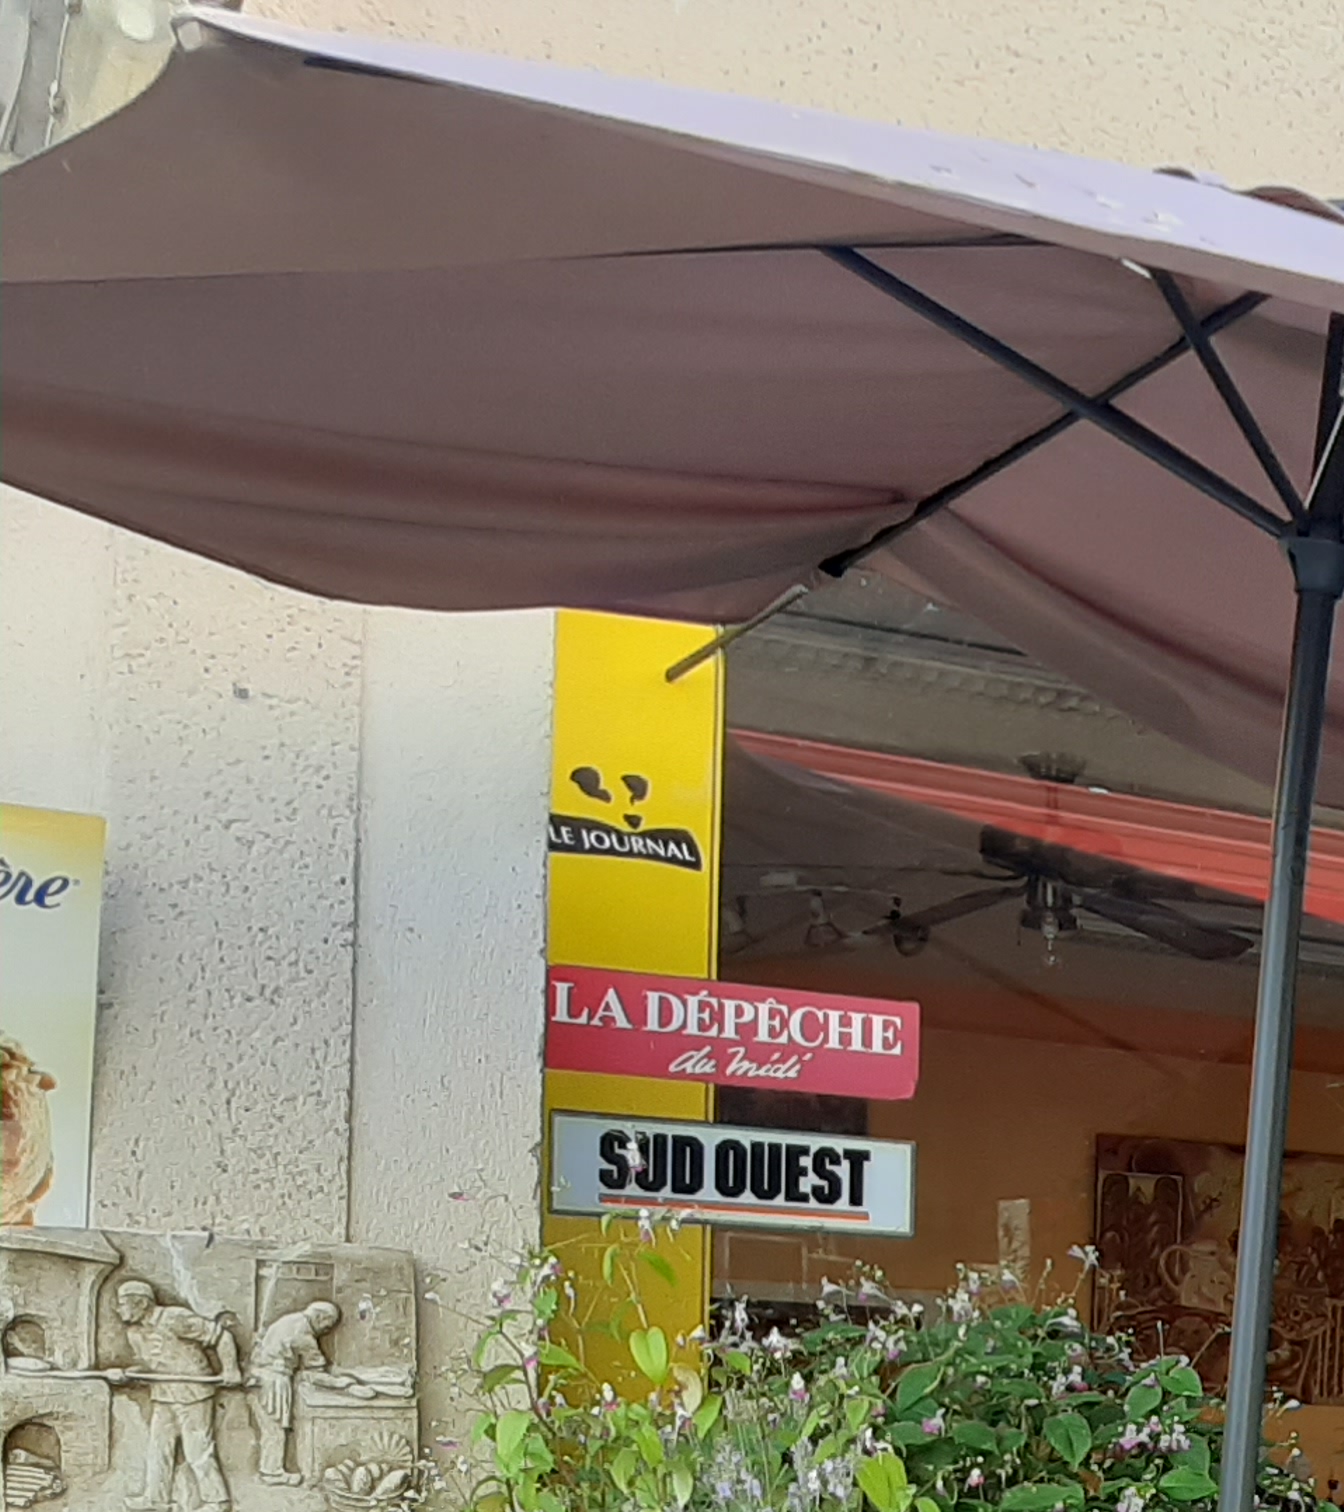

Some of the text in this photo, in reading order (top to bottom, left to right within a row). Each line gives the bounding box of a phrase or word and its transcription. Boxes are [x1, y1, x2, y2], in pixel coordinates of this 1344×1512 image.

[580, 828, 697, 862] JOURNAL
[551, 980, 903, 1057] LA DÉPÊCHE
[668, 1045, 717, 1075] du
[599, 1128, 872, 1207] SUD OUEST
